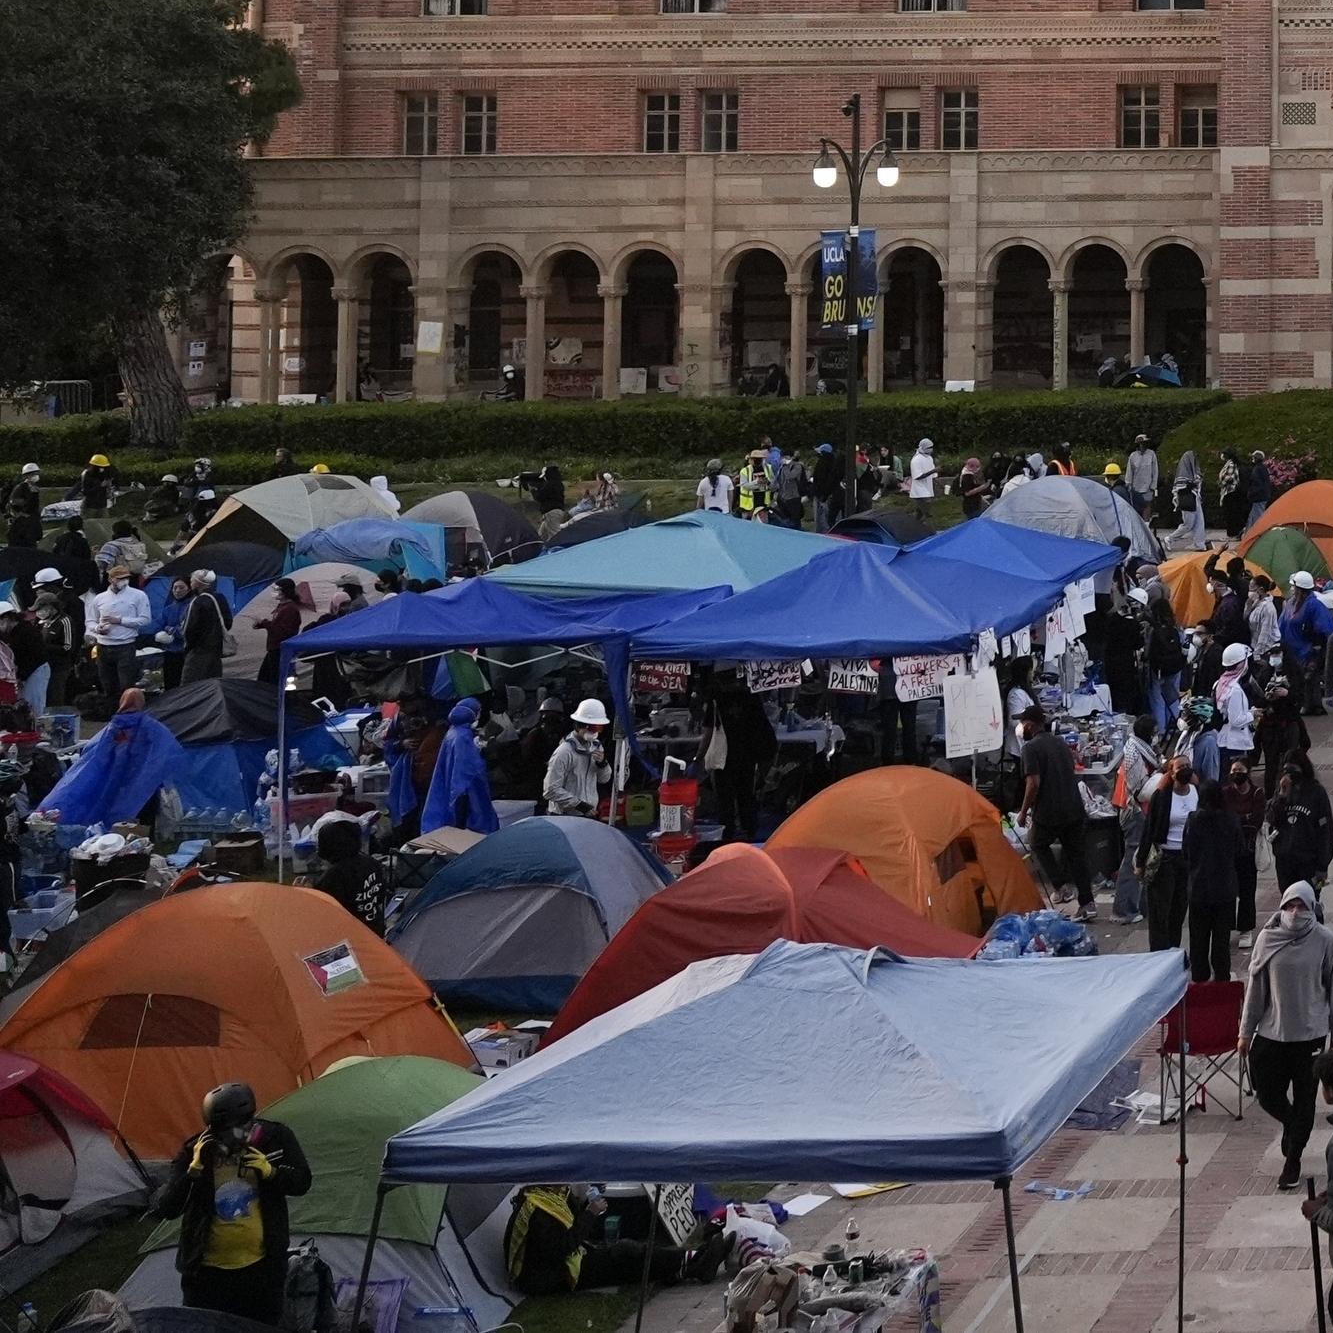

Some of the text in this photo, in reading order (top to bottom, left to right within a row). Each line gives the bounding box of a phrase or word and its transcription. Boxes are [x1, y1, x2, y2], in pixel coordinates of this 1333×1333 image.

[823, 246, 845, 263] UCLA
[825, 274, 844, 298] GO
[664, 662, 687, 675] RIVER
[898, 656, 961, 676] WORKERS 4
[662, 676, 684, 691] SEA
[900, 673, 935, 690] A FREE
[908, 684, 944, 699] PALESTIN
